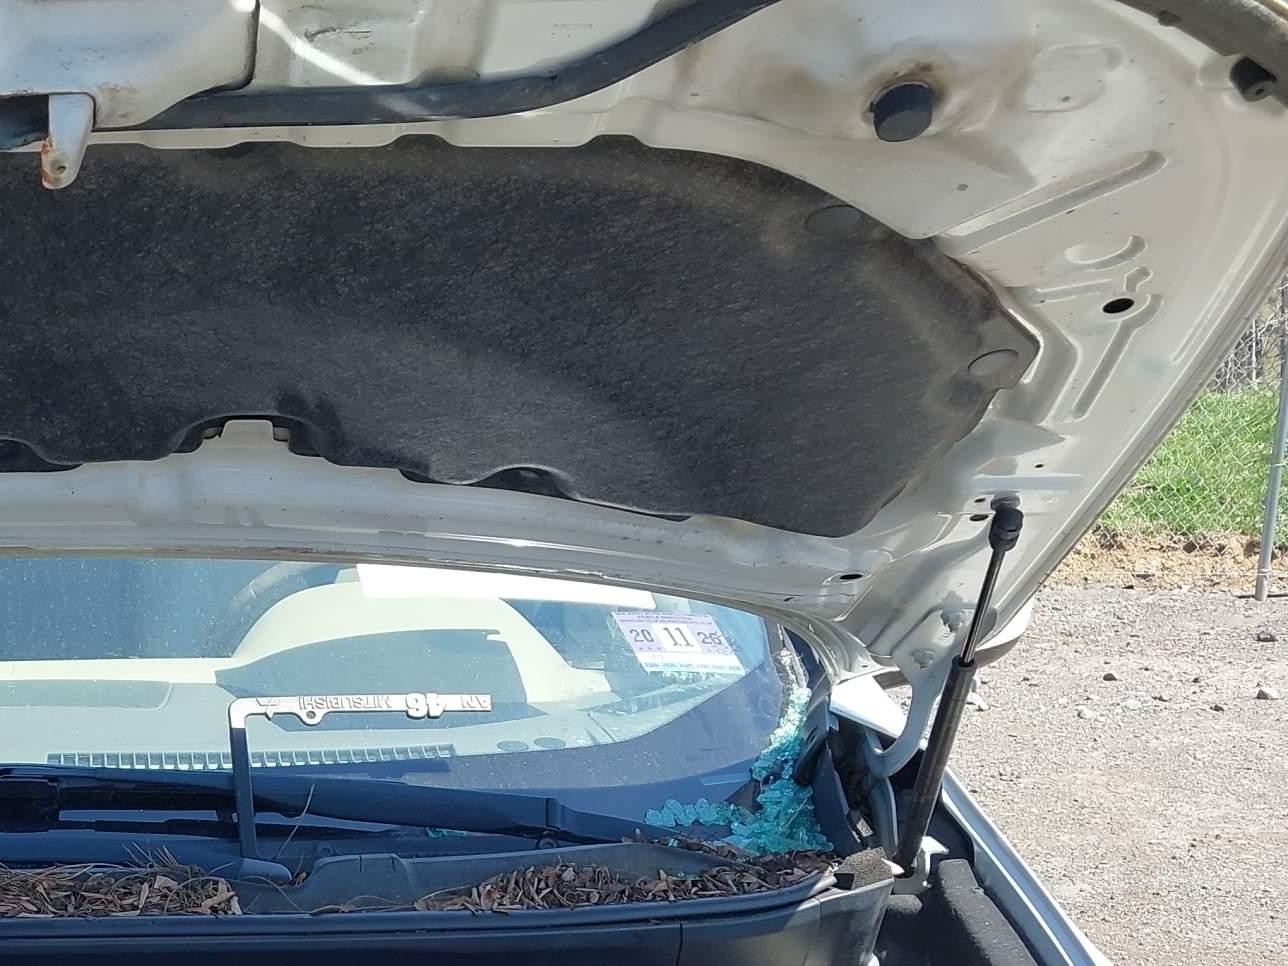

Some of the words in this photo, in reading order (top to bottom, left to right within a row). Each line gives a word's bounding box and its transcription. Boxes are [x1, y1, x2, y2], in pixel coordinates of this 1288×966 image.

[629, 628, 655, 643] 20
[663, 627, 695, 647] 11
[298, 695, 393, 711] MITSUBISHI
[405, 691, 448, 719] 46
